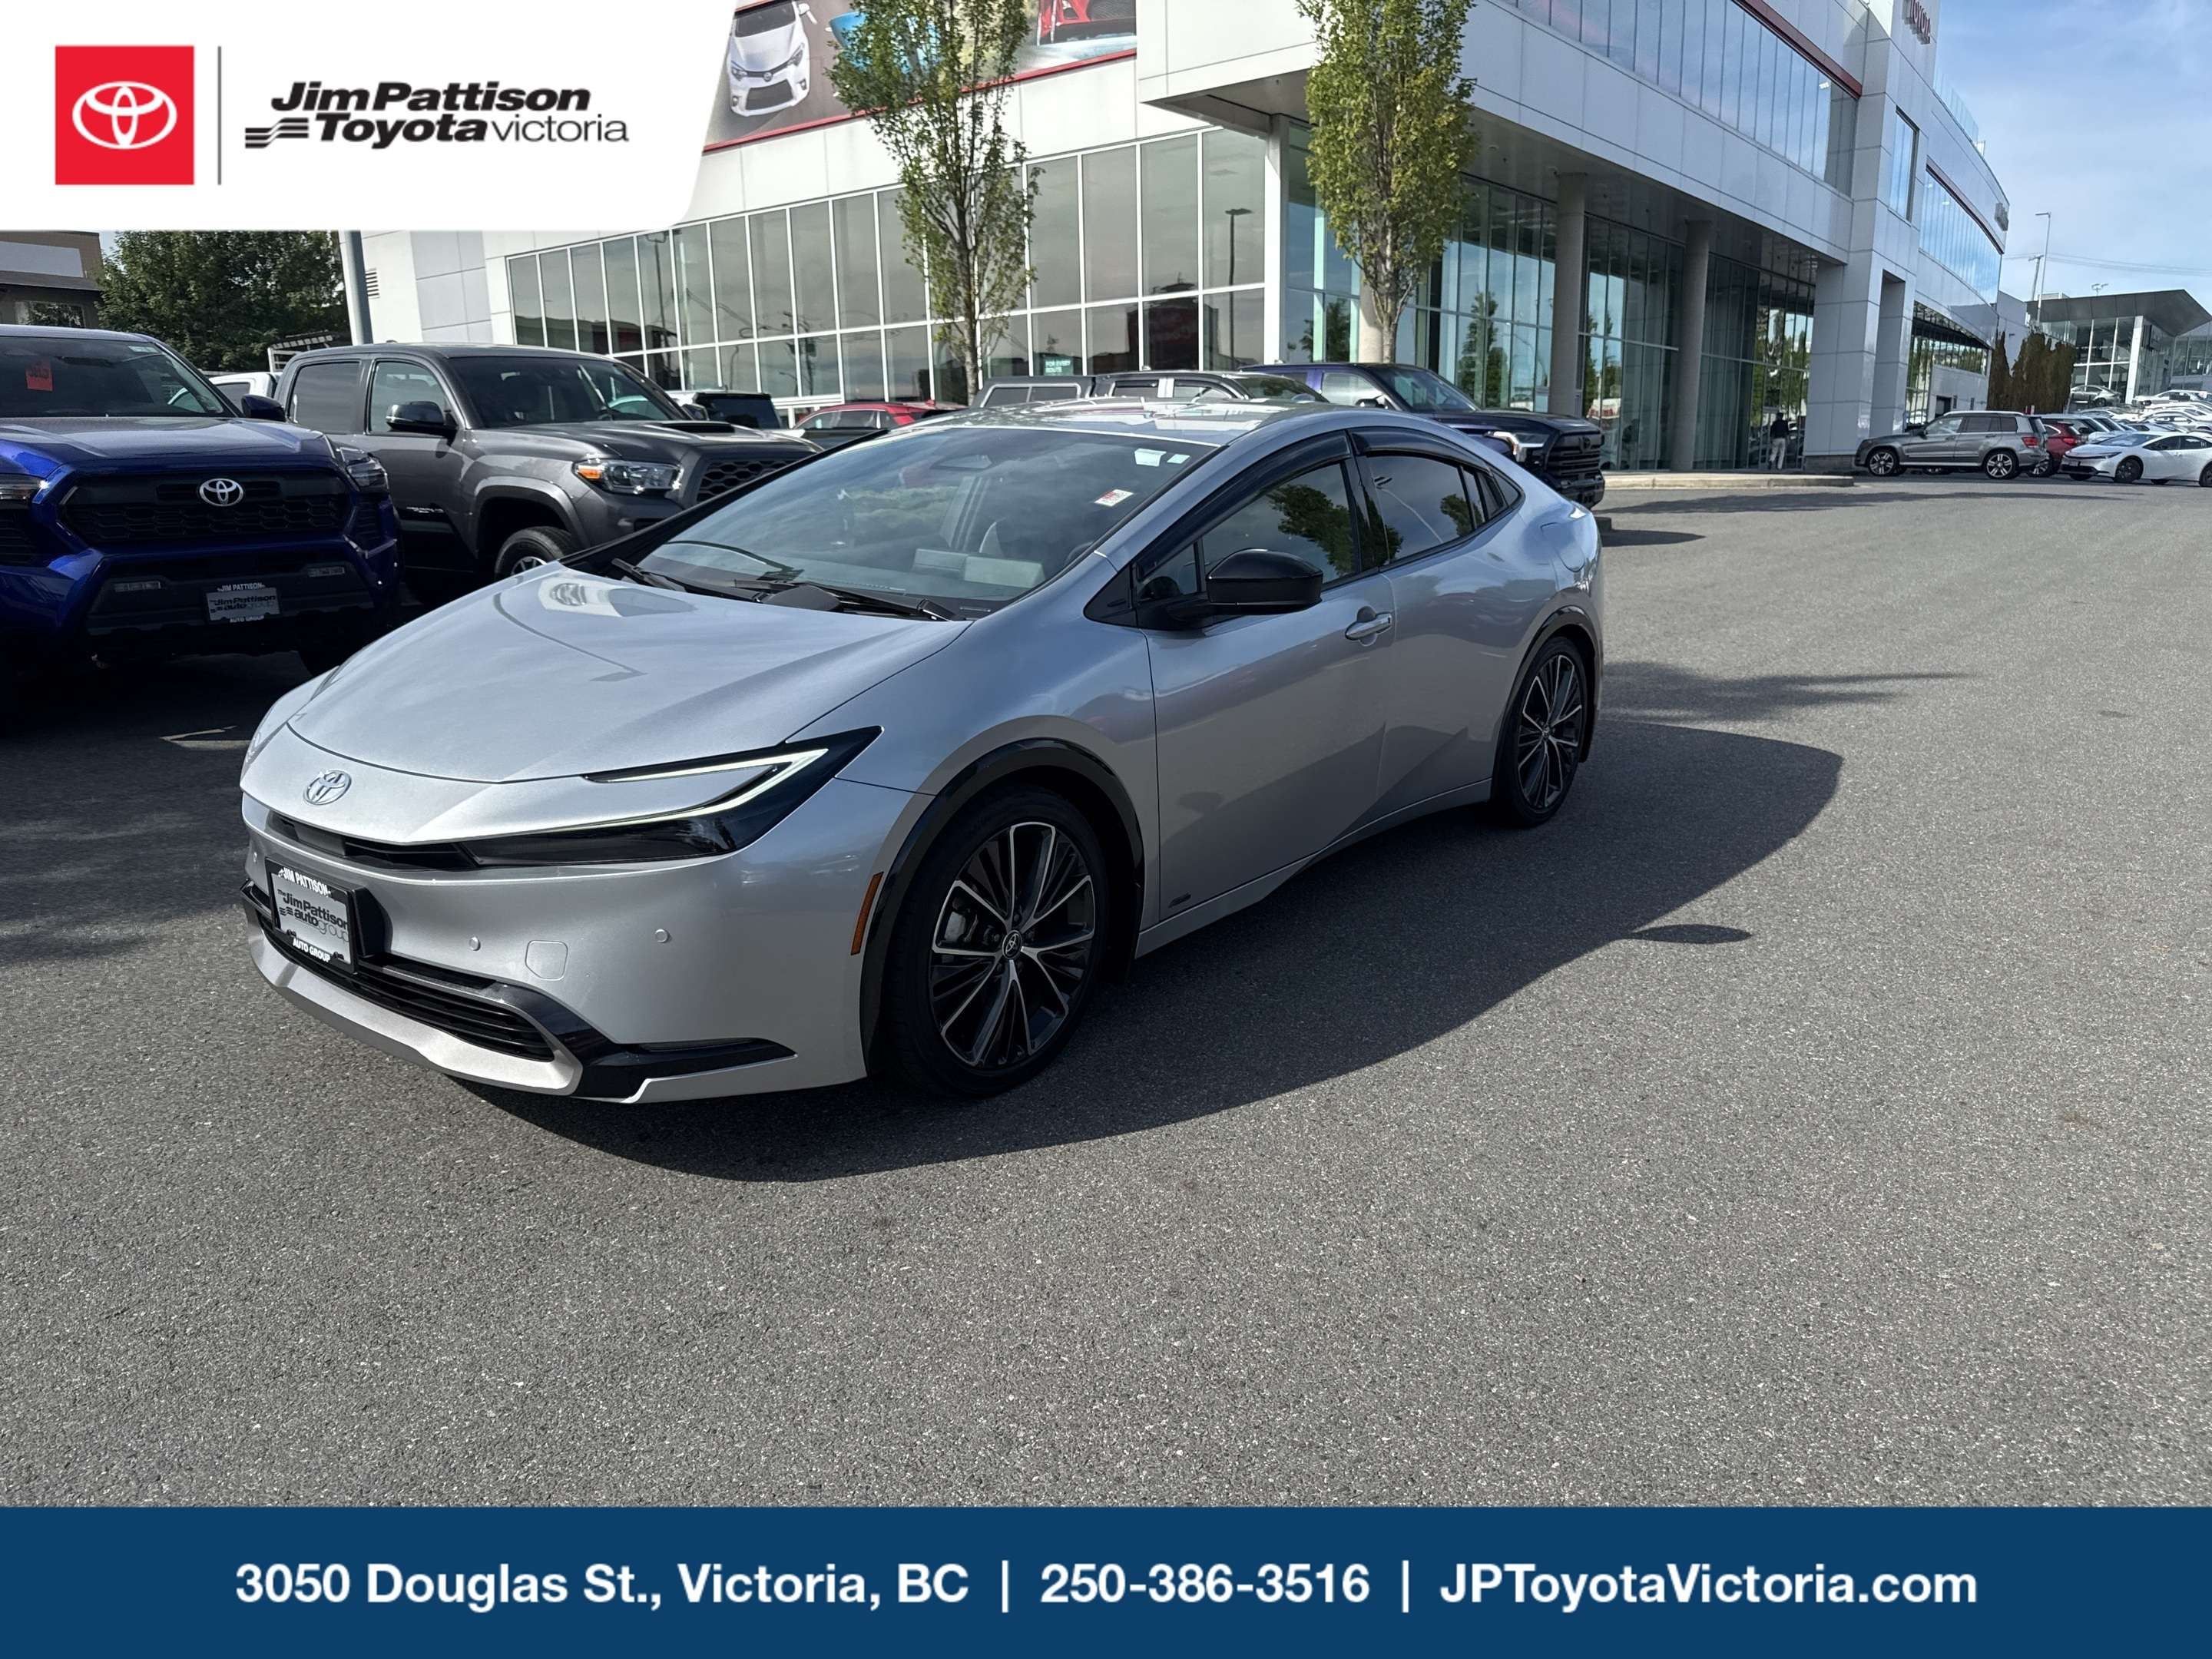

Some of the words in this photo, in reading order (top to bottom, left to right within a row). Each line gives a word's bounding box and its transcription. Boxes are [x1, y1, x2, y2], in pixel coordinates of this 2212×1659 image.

[233, 582, 263, 591] PATTISON
[283, 867, 296, 882] JIM
[295, 872, 329, 896] PATTISON
[293, 938, 309, 952] AUTO
[309, 946, 331, 962] GROUP
